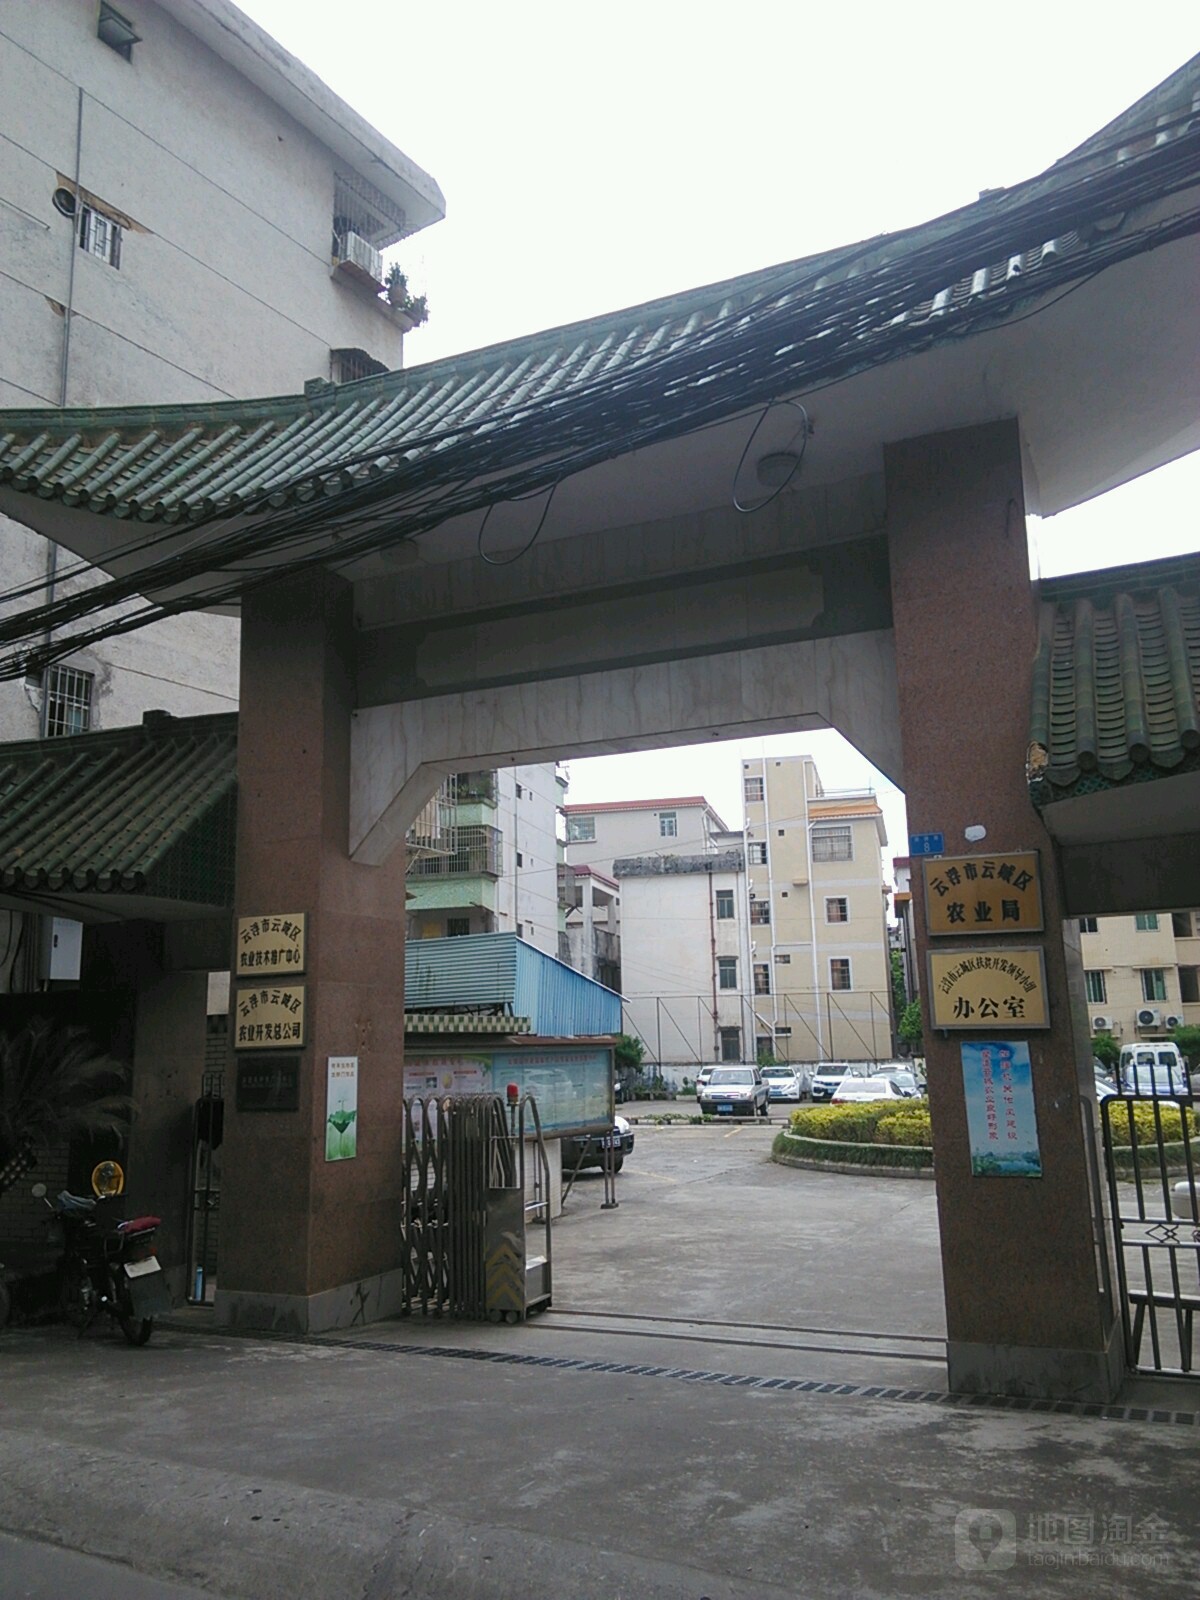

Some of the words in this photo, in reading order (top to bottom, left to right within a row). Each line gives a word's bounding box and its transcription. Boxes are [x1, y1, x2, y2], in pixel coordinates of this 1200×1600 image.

[929, 860, 1034, 897] 云浮市云城区
[946, 899, 1020, 924] 农业局
[240, 918, 301, 946] 云浮市云城区
[240, 944, 301, 967] 农业技术推广中心
[938, 956, 1038, 995] 云浮市云城区扶贫开发领导小组
[238, 989, 302, 1017] 云浮市云城区
[952, 996, 1026, 1019] 办公室
[239, 1021, 301, 1042] 农业开发总公司
